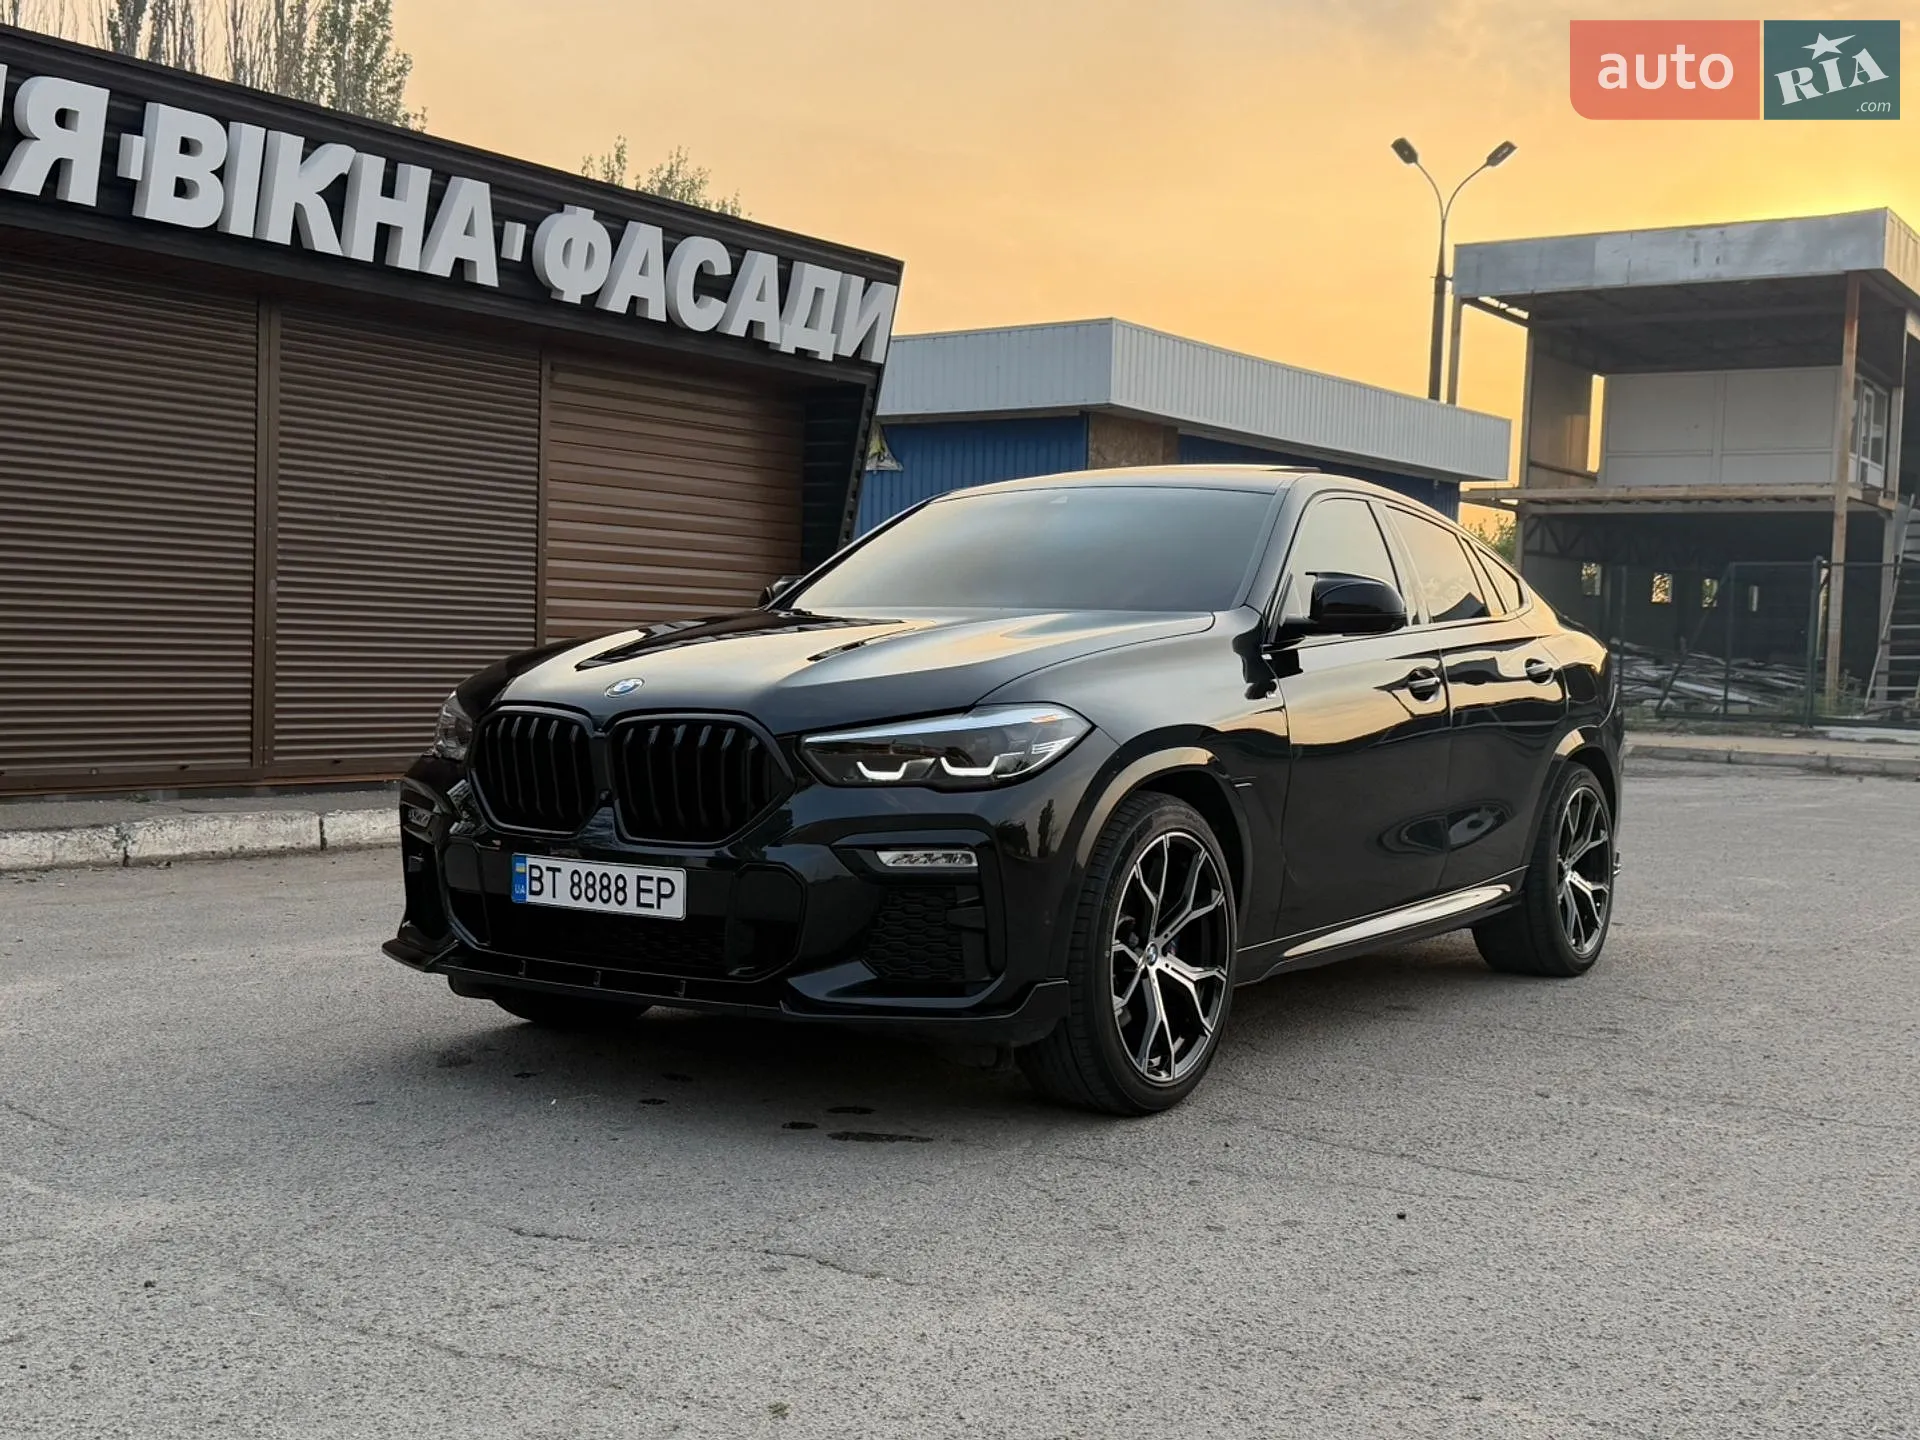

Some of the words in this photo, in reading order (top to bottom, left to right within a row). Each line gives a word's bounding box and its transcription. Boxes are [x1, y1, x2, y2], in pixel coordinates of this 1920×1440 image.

[0, 64, 110, 207] Я
[132, 101, 500, 288] ВІКНА
[532, 203, 897, 363] ФАСАДИ
[528, 864, 562, 898] BT
[570, 869, 628, 906] 8888
[636, 874, 676, 910] EP
